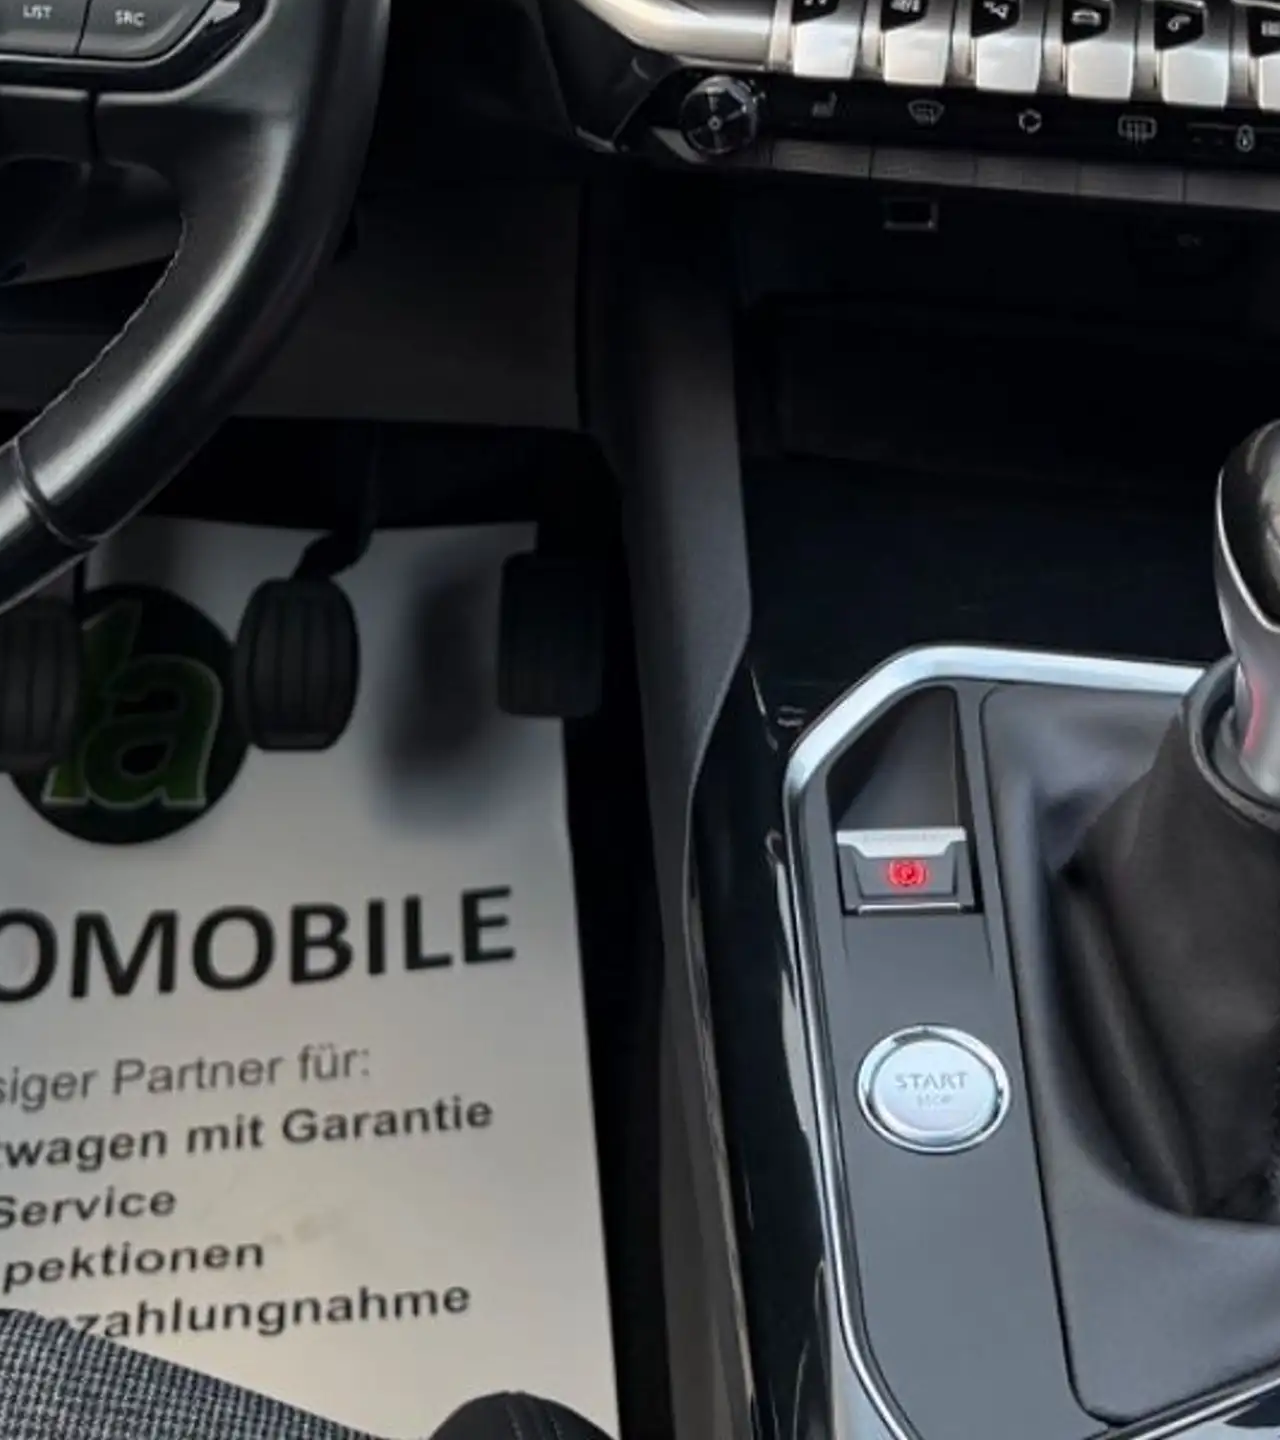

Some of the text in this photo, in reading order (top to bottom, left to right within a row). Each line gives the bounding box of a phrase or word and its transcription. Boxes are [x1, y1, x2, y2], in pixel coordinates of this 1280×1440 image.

[113, 1056, 284, 1096] Partner
[297, 1042, 371, 1082] für:
[894, 1072, 968, 1091] START
[185, 1113, 265, 1154] mit
[281, 1094, 494, 1144] Garantie
